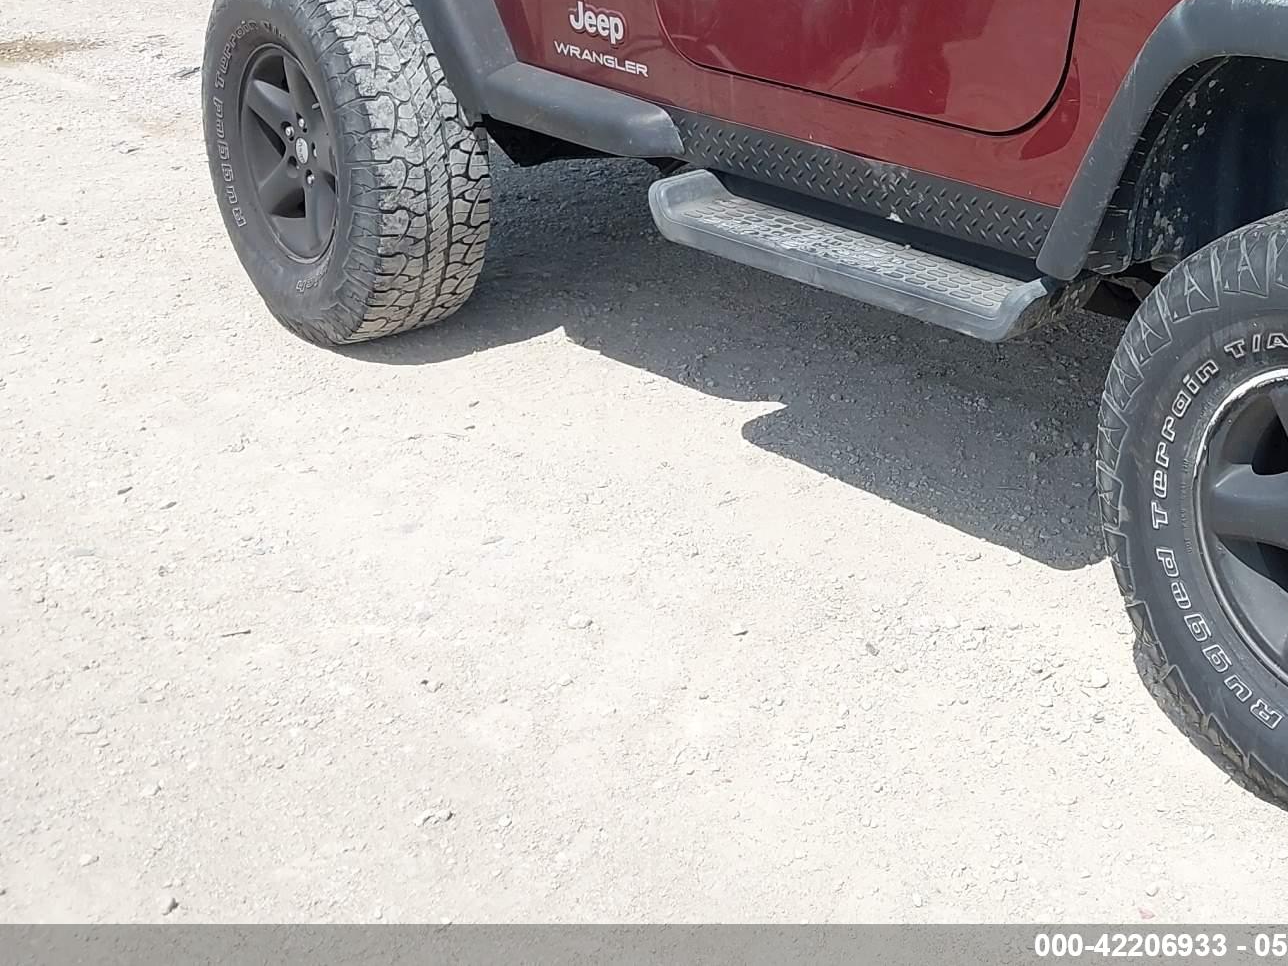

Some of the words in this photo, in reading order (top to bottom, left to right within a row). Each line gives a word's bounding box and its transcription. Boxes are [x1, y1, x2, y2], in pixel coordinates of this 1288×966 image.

[215, 20, 259, 91] Terrain
[569, 0, 625, 45] Jeep
[554, 40, 648, 77] WRANGLER
[1150, 358, 1220, 531] Terrain
[1153, 546, 1286, 731] Rugged
